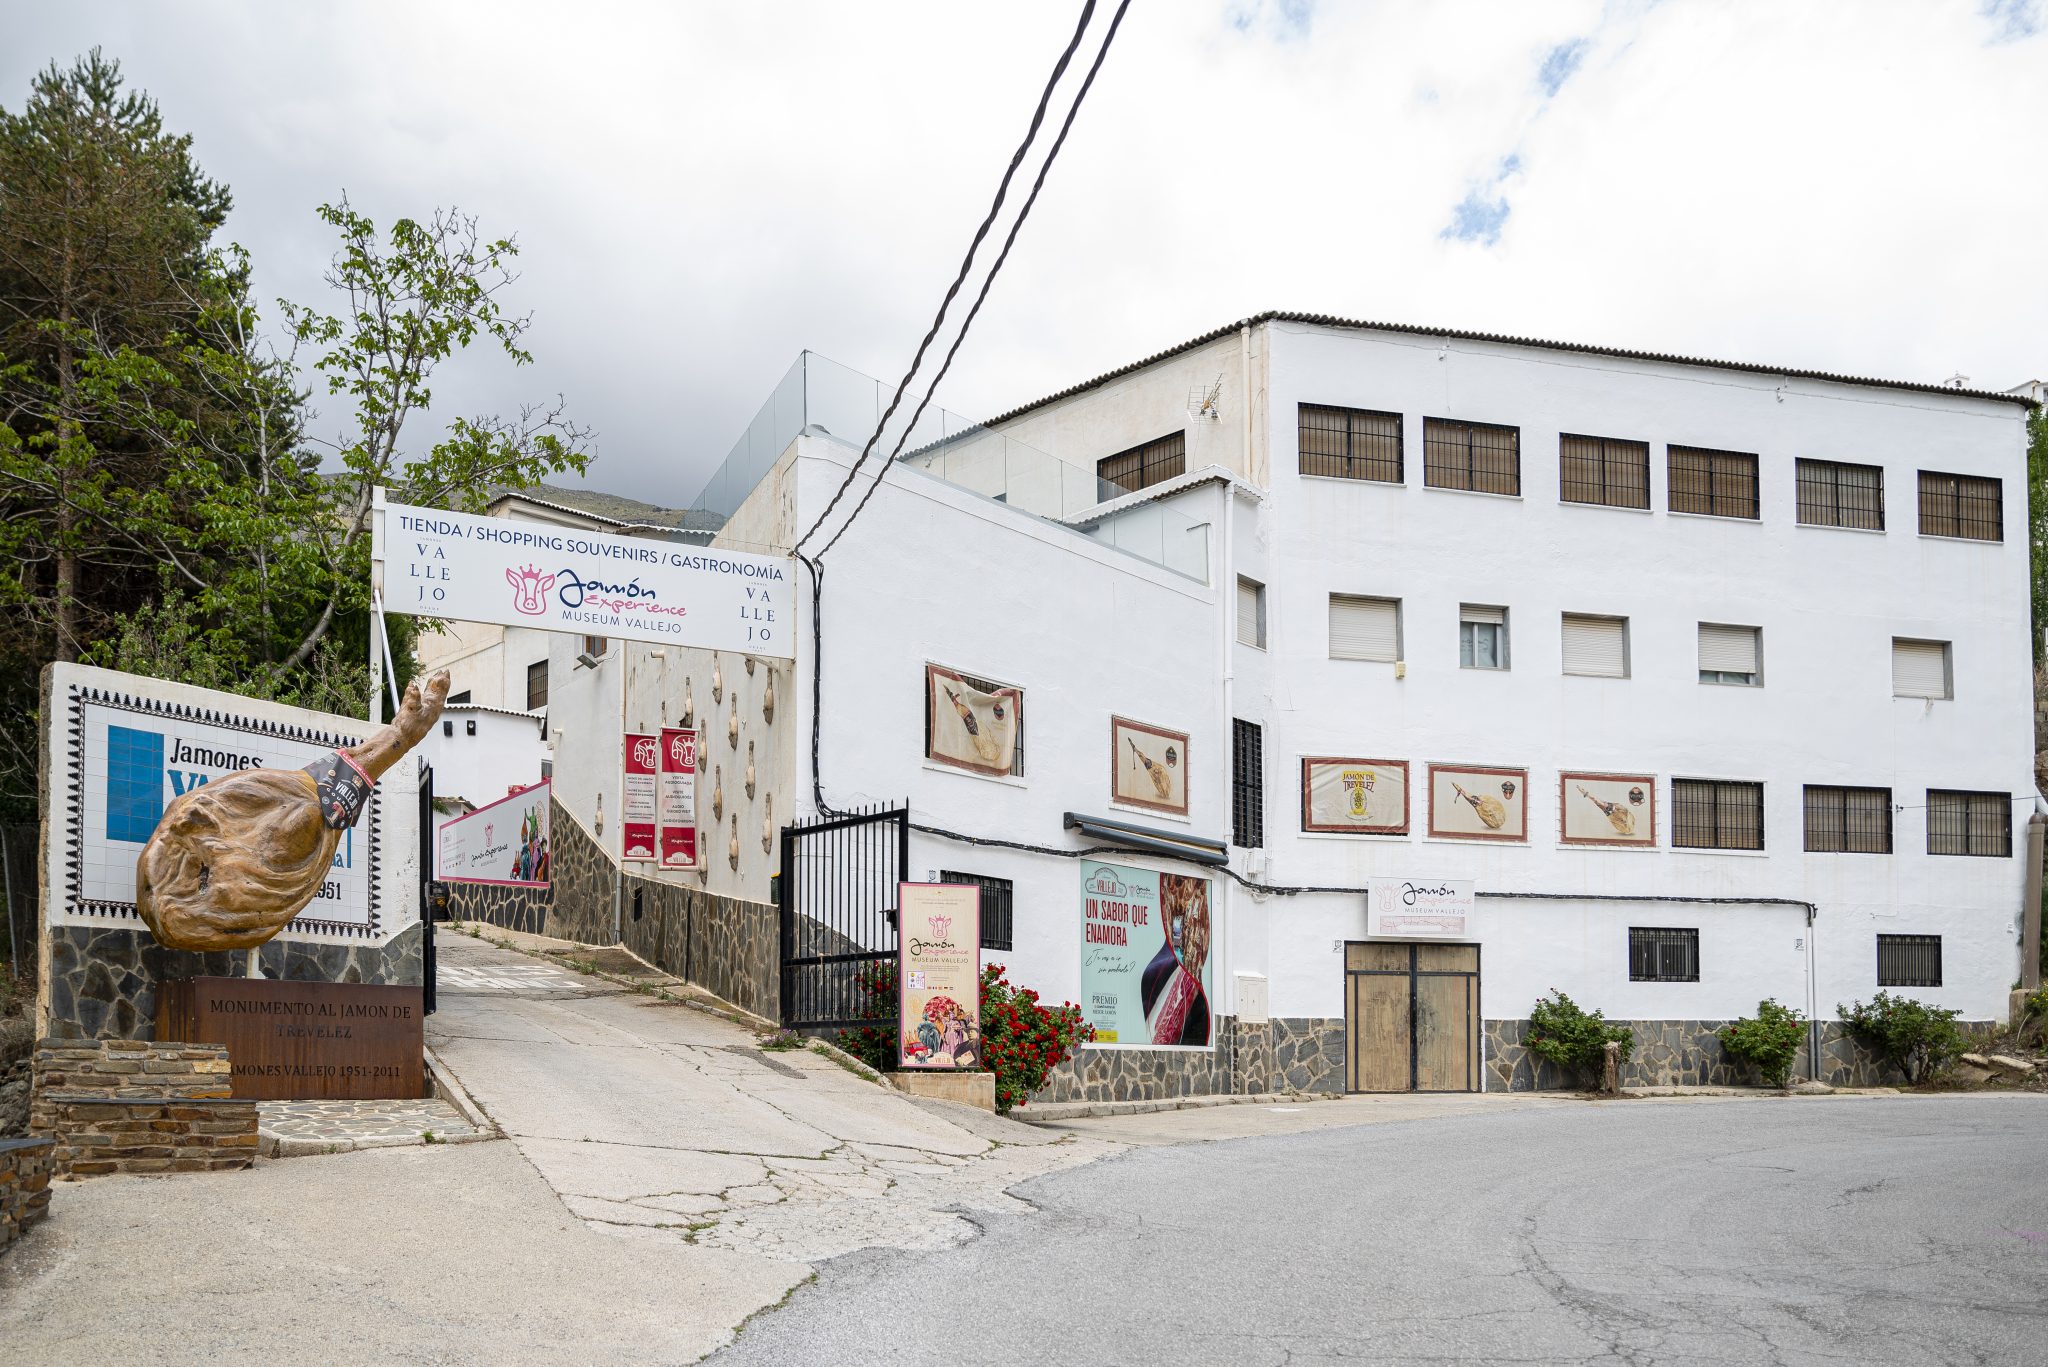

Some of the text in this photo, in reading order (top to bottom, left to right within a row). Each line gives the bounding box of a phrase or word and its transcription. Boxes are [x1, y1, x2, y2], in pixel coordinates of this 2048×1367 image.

[400, 516, 784, 582] TIENDA / SHOPPING SOUVENIRS / GASTRONOMÍA
[557, 568, 656, 608] Jamón
[583, 594, 687, 617] Experience
[562, 609, 682, 634] MUSEUM VALLEJO
[314, 881, 341, 900] 951
[1401, 882, 1455, 905] Jamón
[1086, 898, 1148, 928] UN SABOR QUE
[1086, 922, 1128, 947] ENAMORA
[909, 937, 955, 956] Jamón
[210, 999, 411, 1019] MONUMENTO AL JAMON DE
[1092, 995, 1118, 1006] PREMIO
[276, 1024, 352, 1039] TREVELEZ
[284, 1065, 336, 1078] VALLEJO
[339, 1065, 400, 1078] 1951-2011
